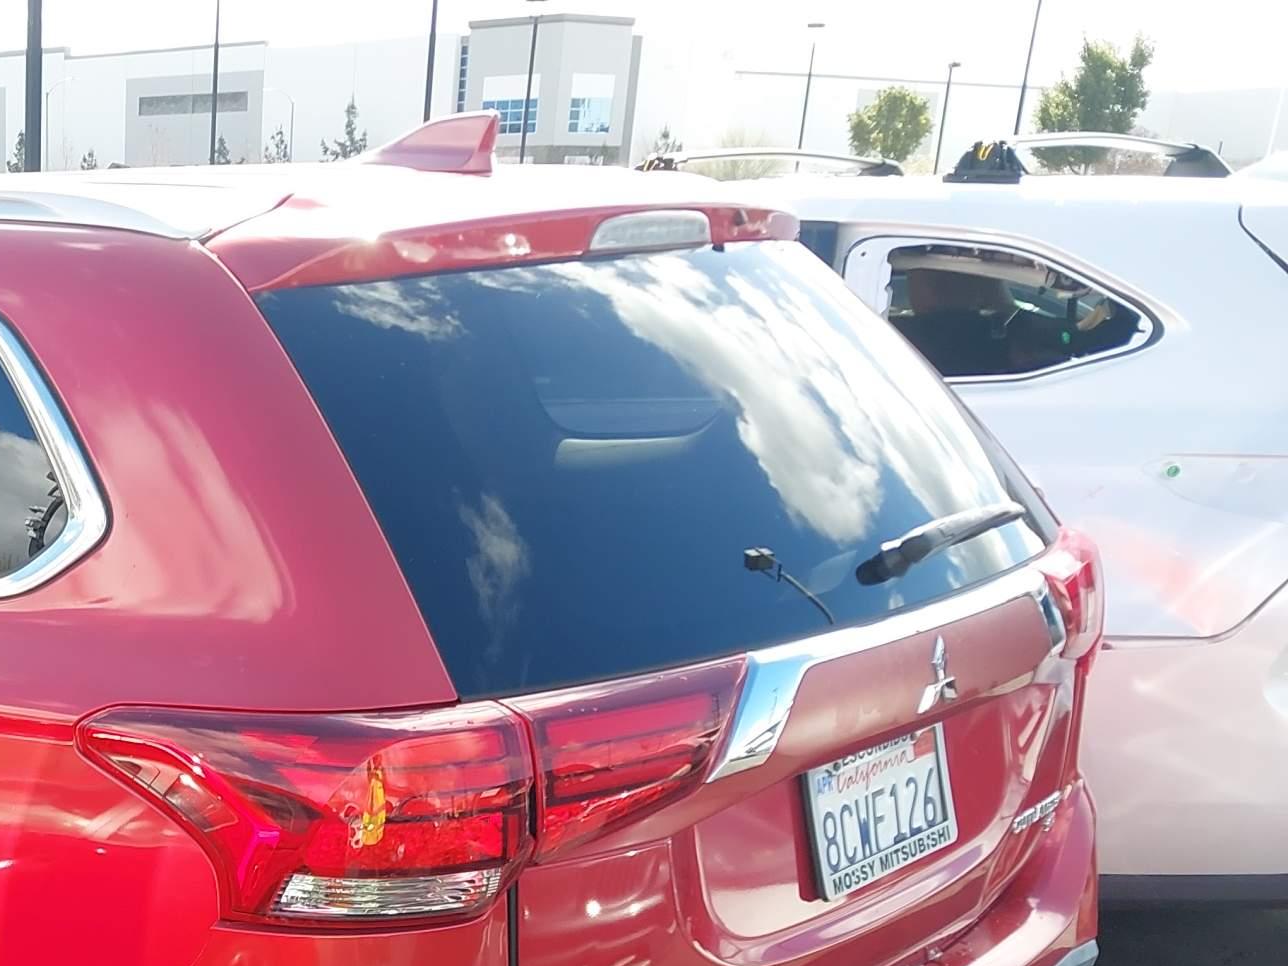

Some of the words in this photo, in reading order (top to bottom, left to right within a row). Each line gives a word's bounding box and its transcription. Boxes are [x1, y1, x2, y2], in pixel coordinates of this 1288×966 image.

[836, 749, 914, 793] California
[823, 766, 938, 873] 8CWF126
[832, 860, 875, 895] MOSSY
[879, 824, 952, 872] MITSUBISHI
